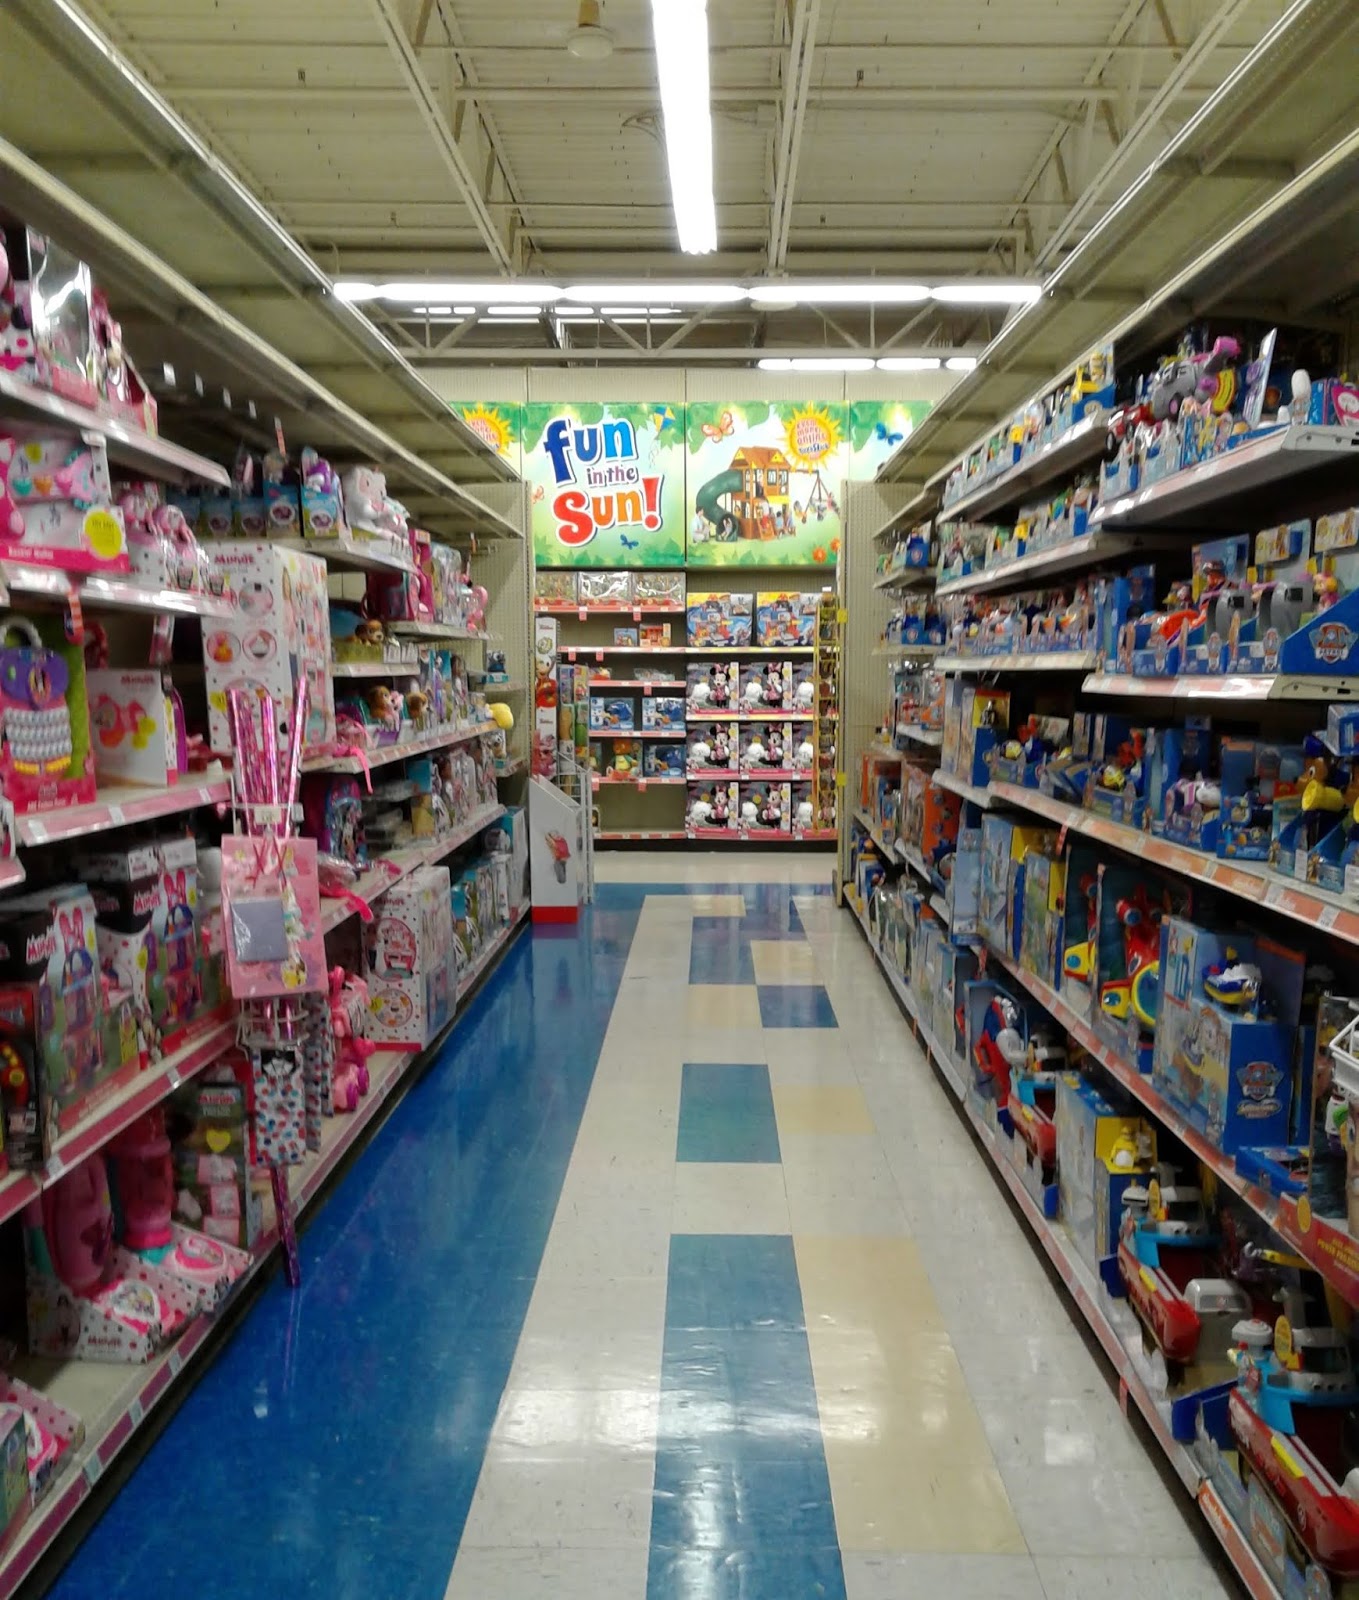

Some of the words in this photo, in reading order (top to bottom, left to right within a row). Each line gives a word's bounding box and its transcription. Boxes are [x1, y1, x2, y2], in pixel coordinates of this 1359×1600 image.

[543, 419, 634, 484] fun
[586, 467, 603, 485] in
[606, 465, 636, 483] the
[553, 476, 660, 544] Sun!
